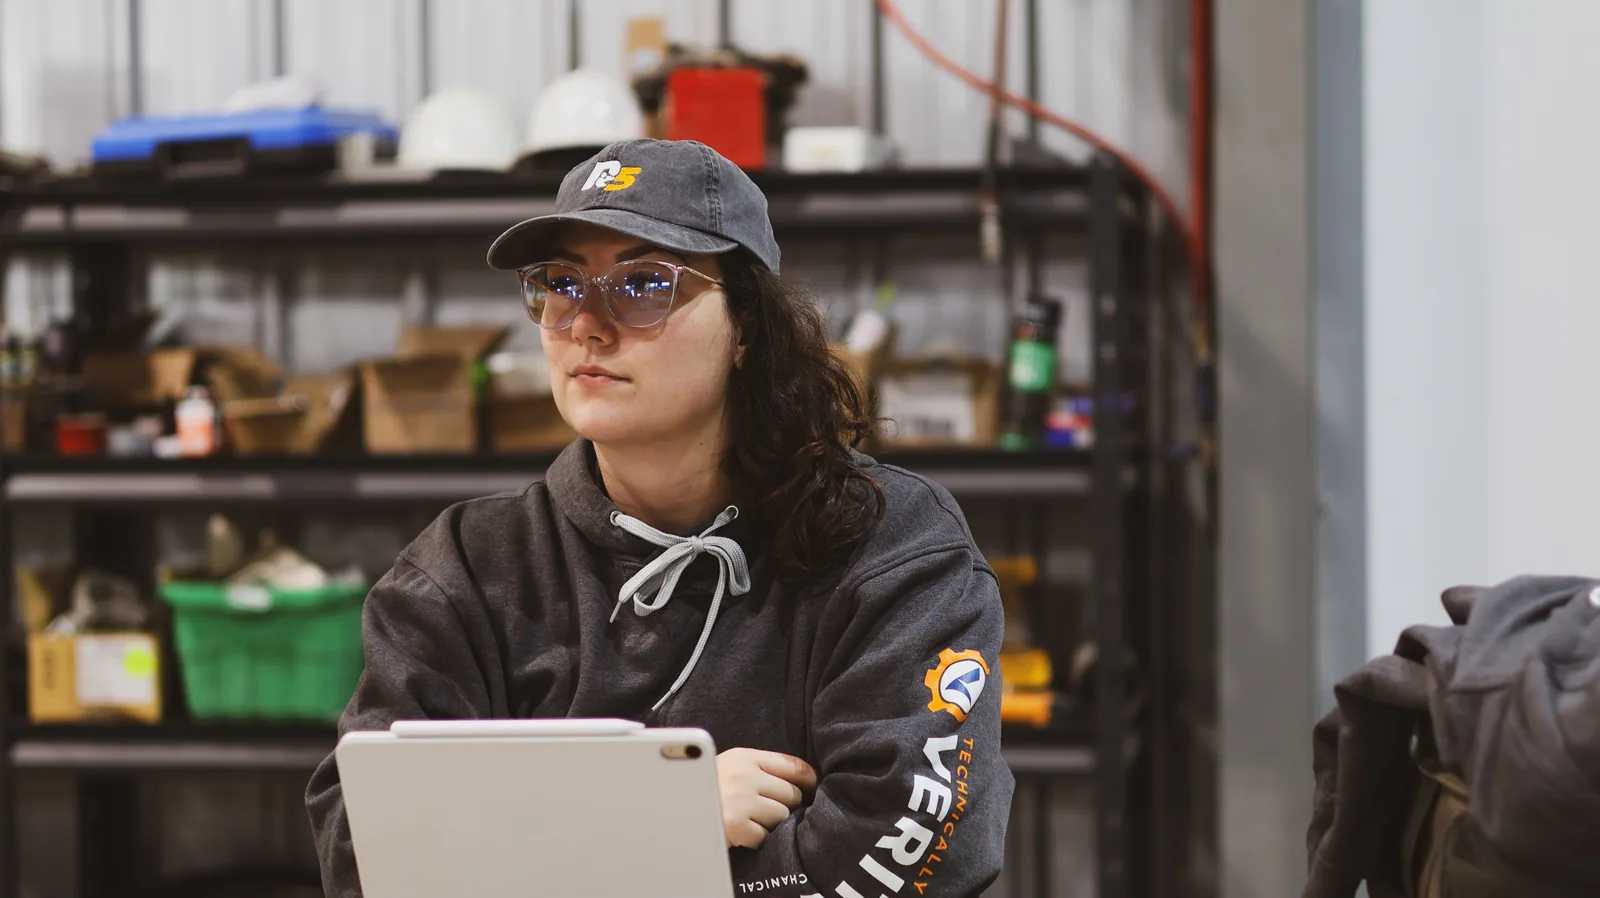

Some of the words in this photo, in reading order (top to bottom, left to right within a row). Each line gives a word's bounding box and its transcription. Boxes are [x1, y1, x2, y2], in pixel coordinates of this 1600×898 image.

[739, 873, 808, 893] CHANICAL
[801, 735, 958, 898] VERI
[913, 738, 974, 895] TECHNICALLY
